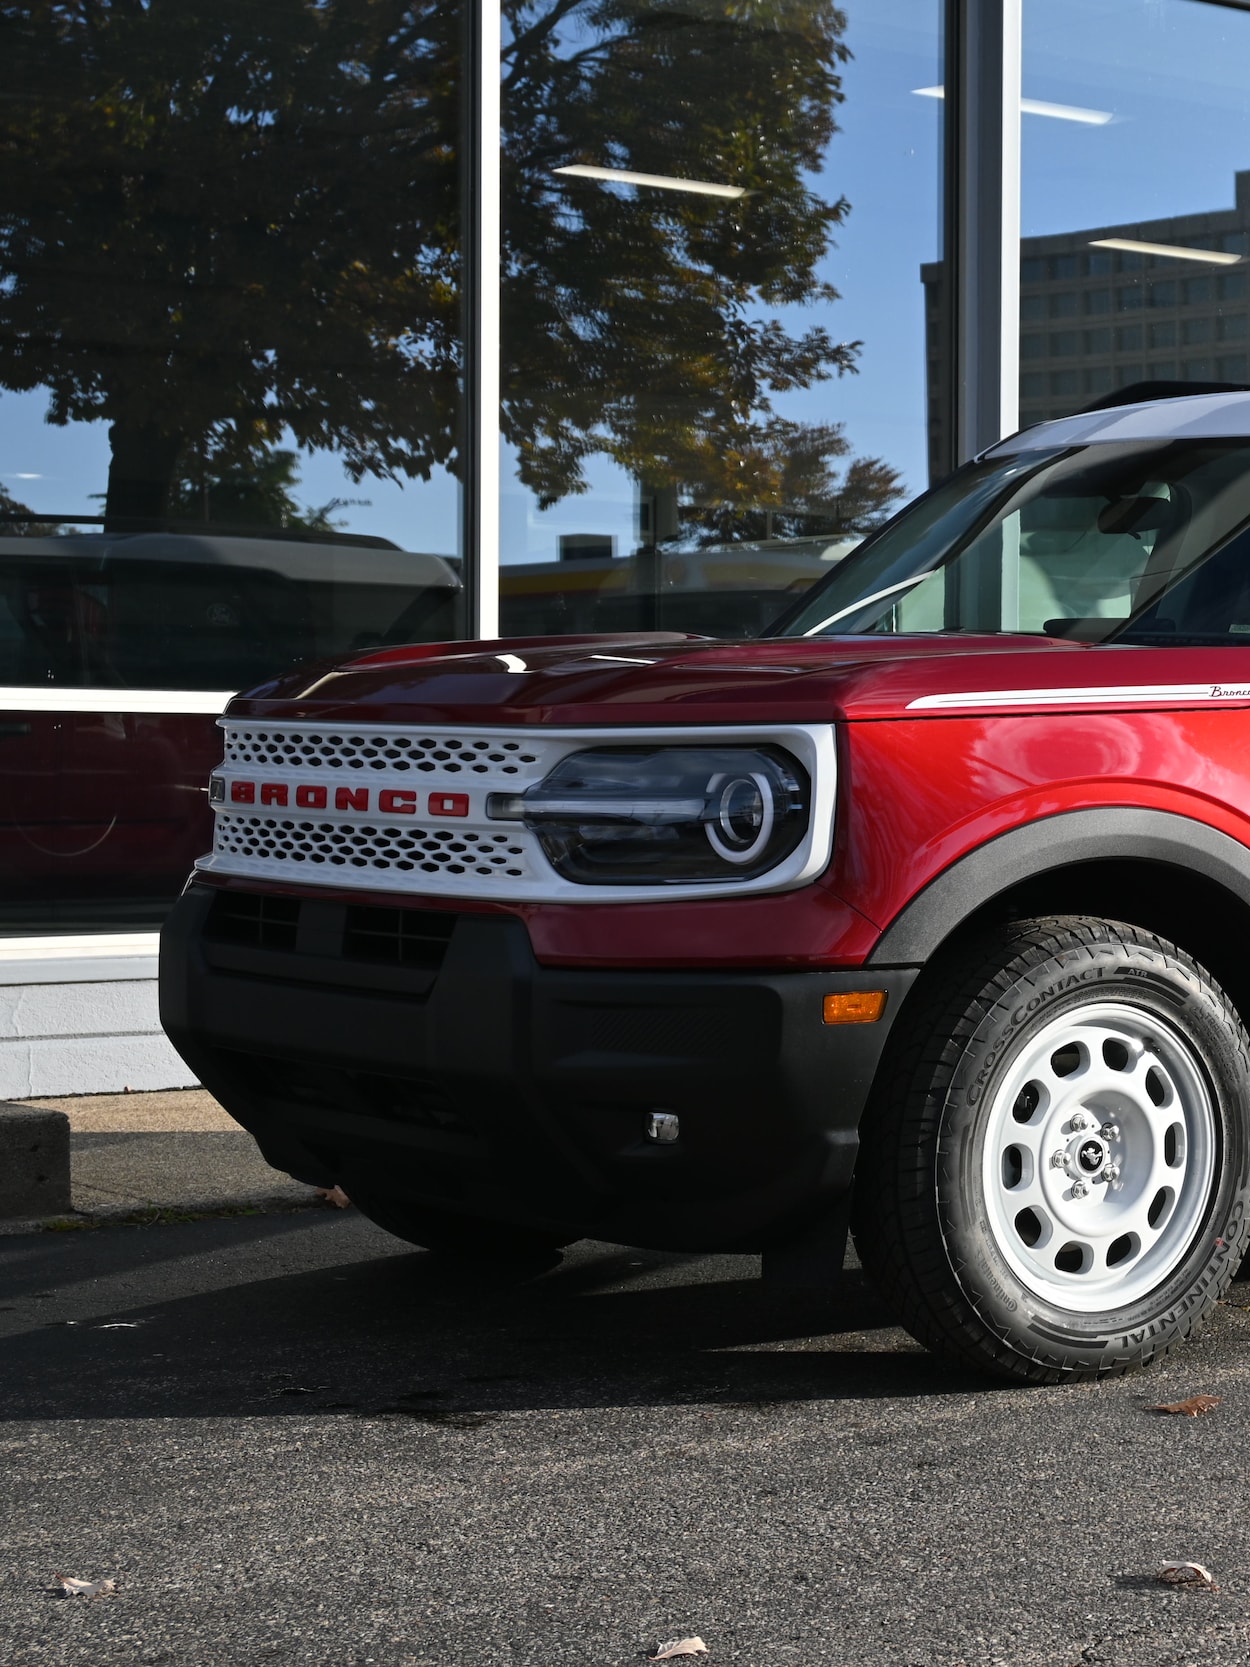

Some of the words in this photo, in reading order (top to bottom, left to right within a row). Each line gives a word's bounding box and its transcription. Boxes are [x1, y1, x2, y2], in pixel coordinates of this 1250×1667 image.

[231, 780, 470, 818] BRONCO
[1127, 967, 1149, 978] ATR
[977, 1257, 1018, 1313] Continental
[1114, 1200, 1244, 1349] CONTINENTAL
